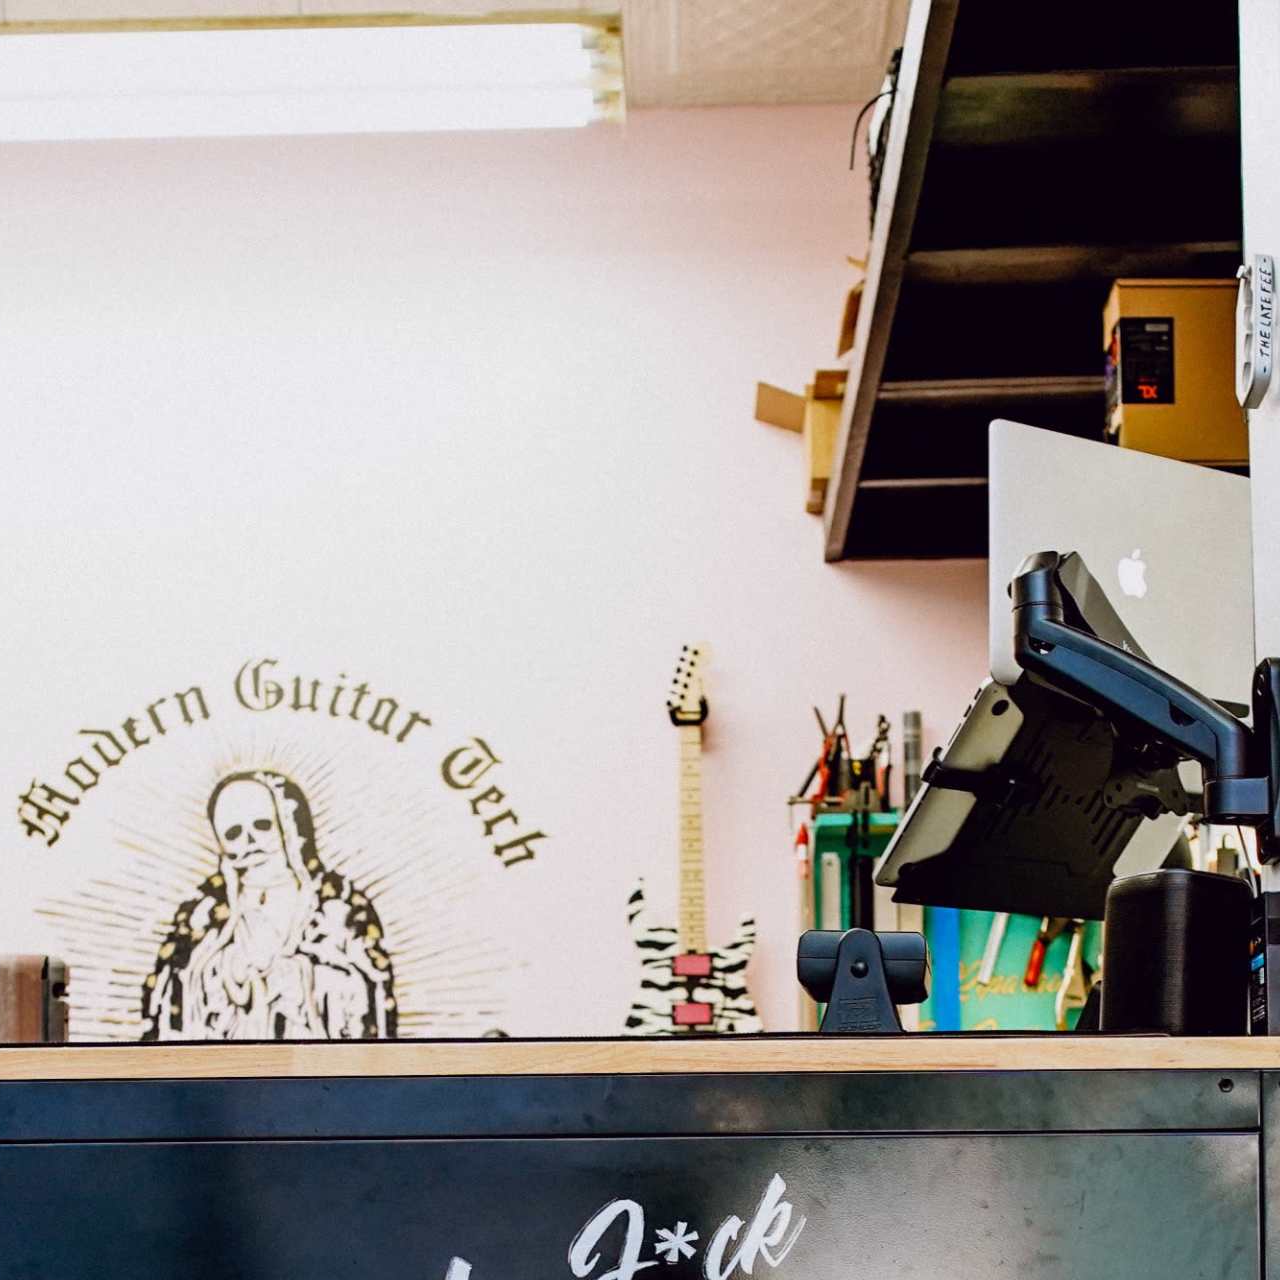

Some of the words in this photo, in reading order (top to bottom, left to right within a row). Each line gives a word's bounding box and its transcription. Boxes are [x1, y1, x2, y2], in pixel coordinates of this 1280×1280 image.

[1259, 267, 1273, 294] FEE
[1260, 296, 1272, 327] LATE
[1259, 330, 1271, 358] THE
[16, 684, 212, 848] Modern
[232, 658, 433, 744] Guitar
[439, 735, 554, 869] Tech
